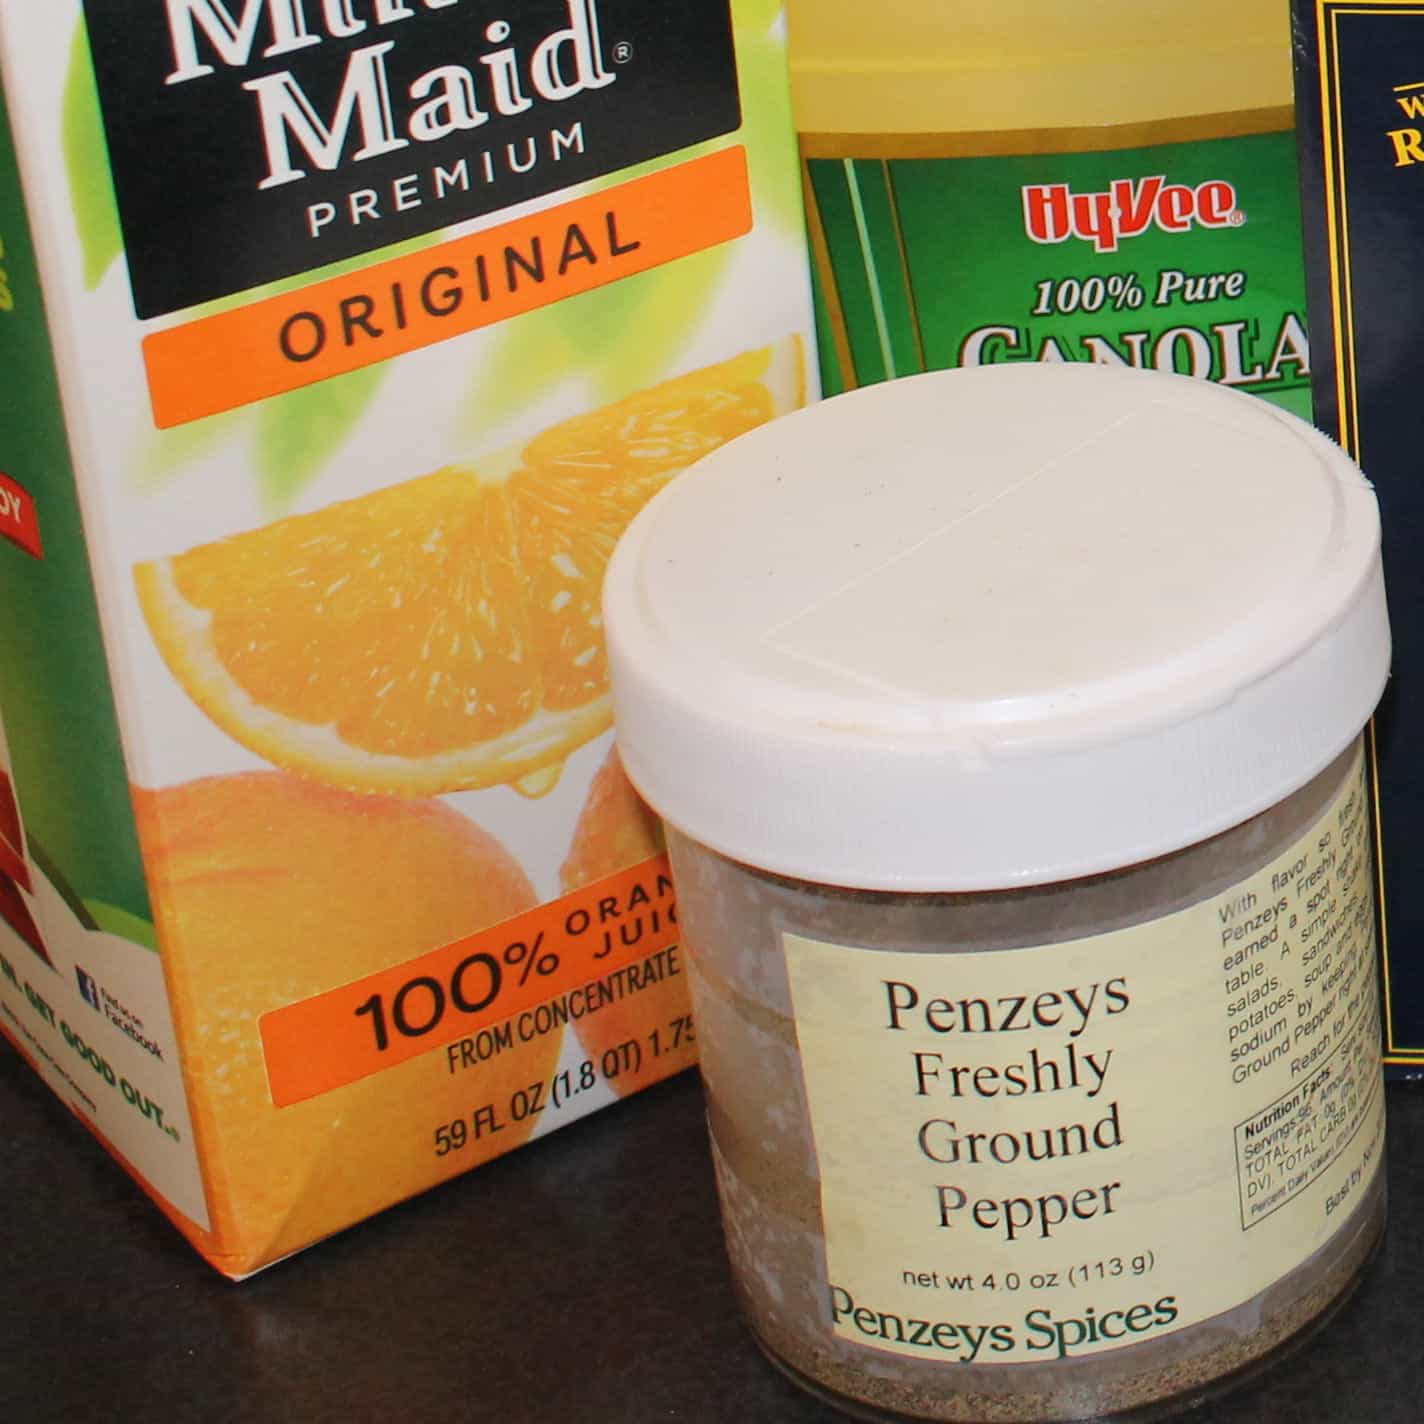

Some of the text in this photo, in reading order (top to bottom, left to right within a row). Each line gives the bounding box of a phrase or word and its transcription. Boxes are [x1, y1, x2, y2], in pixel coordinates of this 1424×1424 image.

[310, 122, 586, 238] PREMIUM
[1022, 176, 1238, 253] HyVee
[279, 211, 641, 363] ORIGINAL
[1034, 270, 1244, 316] 100% Pure
[593, 904, 678, 960] JUI
[1219, 892, 1257, 923] With
[1221, 895, 1288, 949] Penzeys
[355, 873, 674, 1052] 100% ORAN
[447, 945, 682, 1074] FROM CONCENTRATE
[881, 975, 1131, 1041] Penzeys
[434, 1119, 467, 1158] 59
[473, 1106, 505, 1140] FL
[510, 1082, 546, 1122] OZ
[552, 1061, 597, 1108] (1.8
[600, 1038, 643, 1080] QT)
[913, 1043, 1116, 1098] Freshly
[917, 1103, 1125, 1168] Ground
[1245, 1095, 1299, 1139] Nutrition
[934, 1180, 1122, 1241] Pepper
[902, 1249, 1156, 1293] net wt 4.0 oz (113 g)
[829, 1284, 1179, 1364] Penzeys Spices
